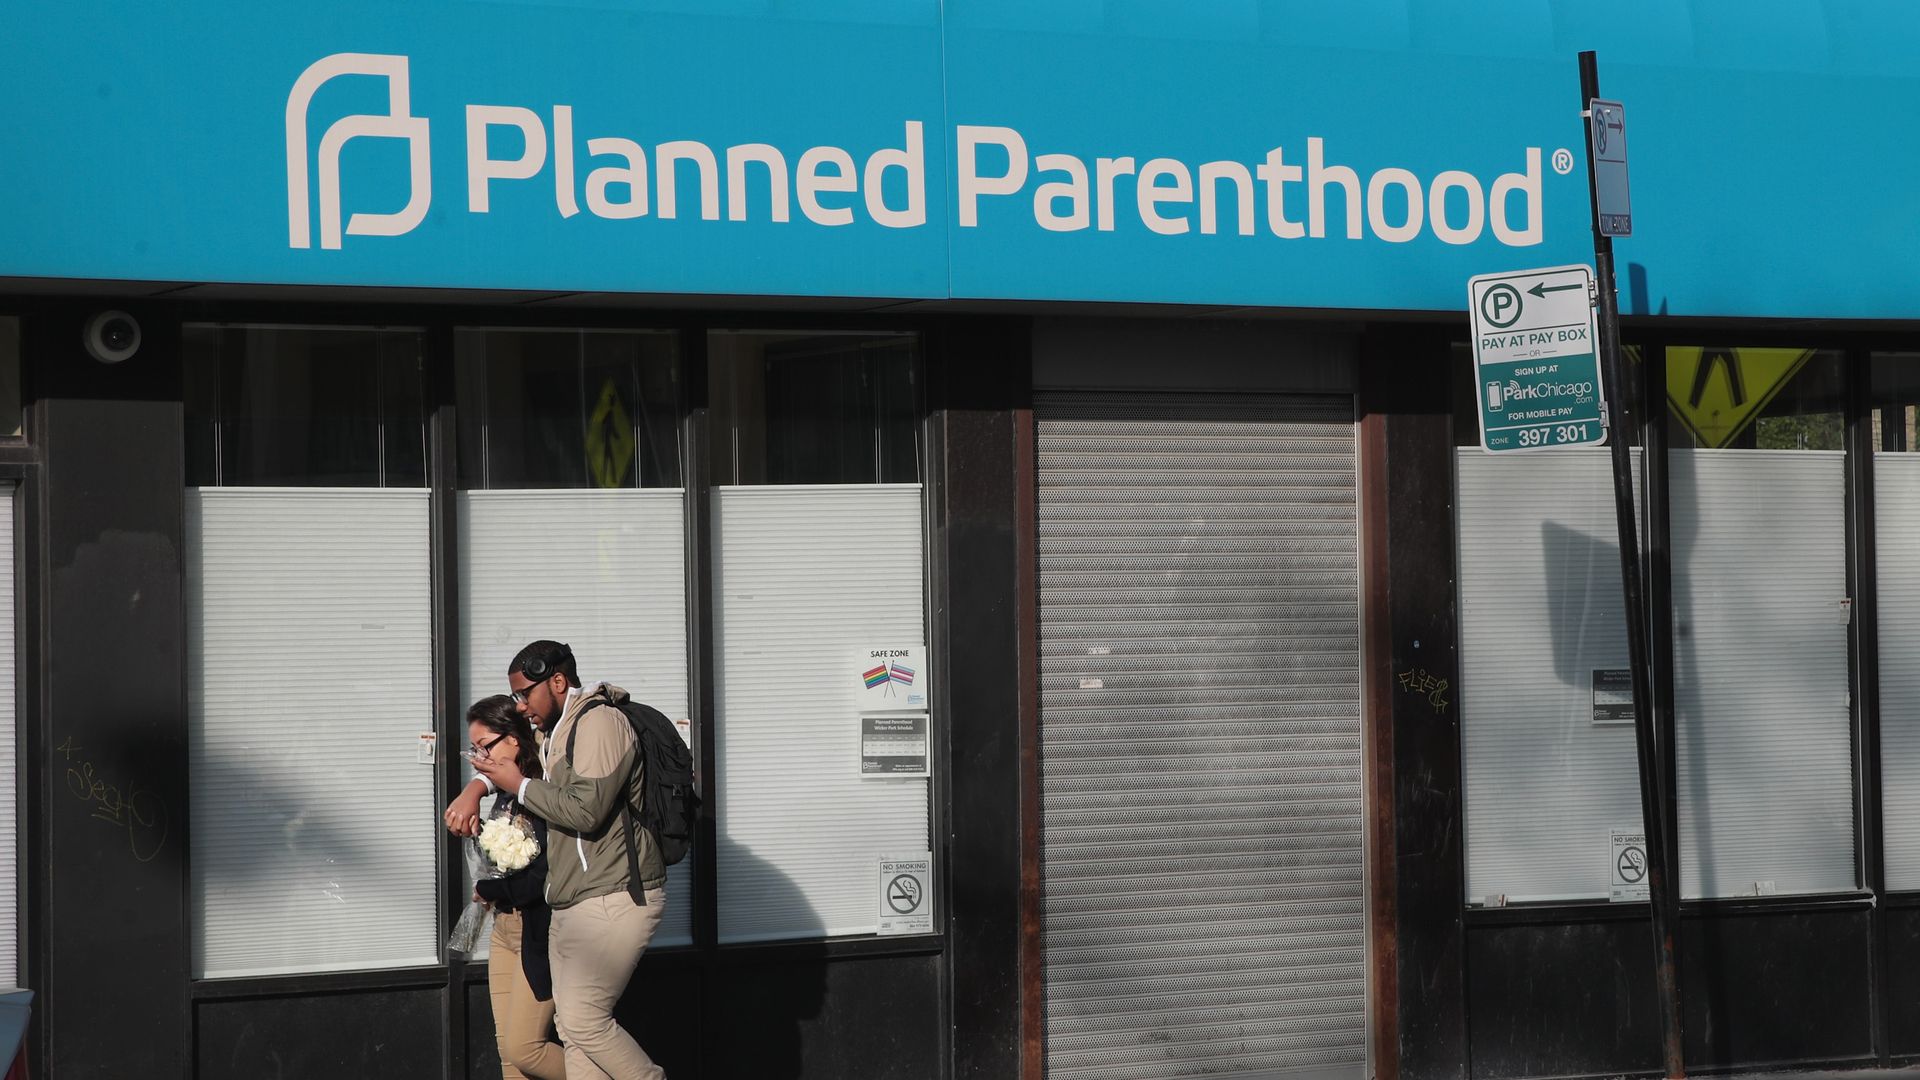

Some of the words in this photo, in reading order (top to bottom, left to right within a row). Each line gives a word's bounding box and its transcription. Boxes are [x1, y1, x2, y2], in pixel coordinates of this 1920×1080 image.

[465, 104, 926, 228] Planned
[957, 125, 1543, 247] Parenthood
[1482, 336, 1506, 350] PAY
[1509, 335, 1526, 348] AT
[1529, 331, 1554, 346] PAY
[1558, 328, 1588, 342] BOX
[1529, 349, 1541, 357] OR
[1514, 367, 1534, 376] SIGN
[1535, 366, 1547, 375] UP
[1548, 364, 1559, 373] AT
[1503, 381, 1593, 401] ParkChicago
[1508, 412, 1525, 421] FOR
[1525, 409, 1557, 419] MOBILE
[1558, 407, 1574, 416] PAY
[1490, 437, 1510, 445] ZONE
[1518, 428, 1550, 447] 397
[1556, 424, 1589, 443] 301
[870, 650, 888, 658] SAFE
